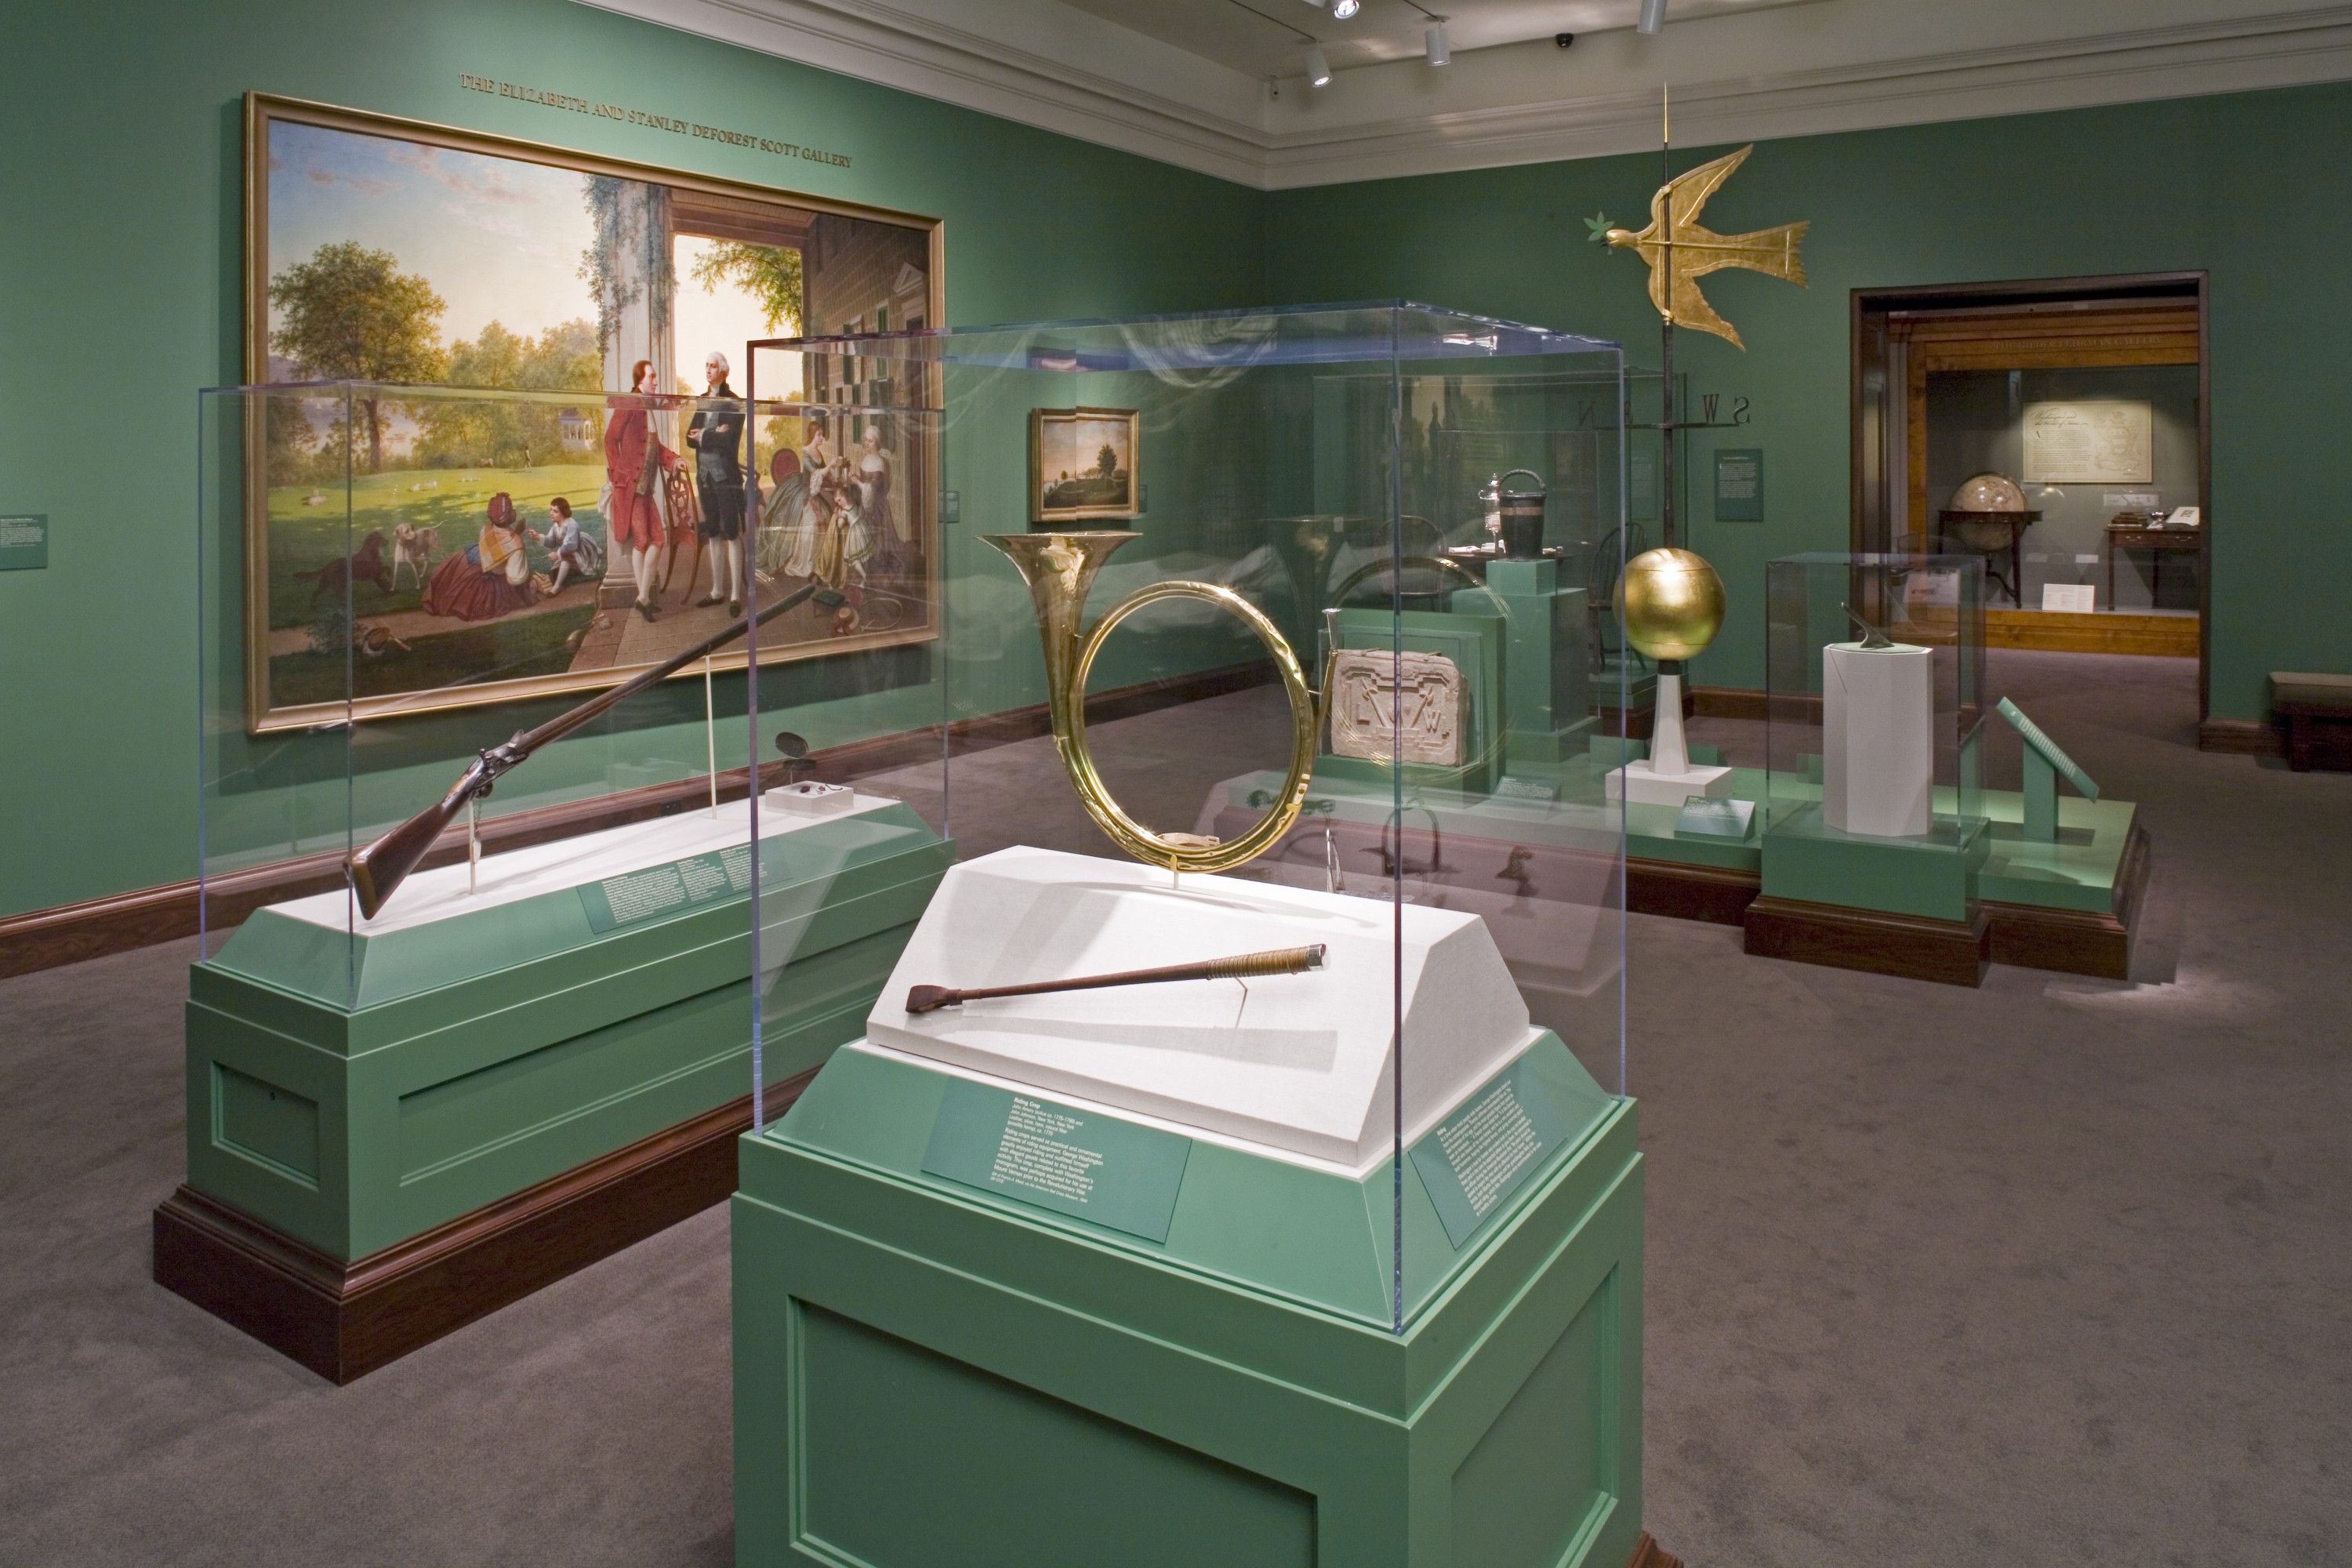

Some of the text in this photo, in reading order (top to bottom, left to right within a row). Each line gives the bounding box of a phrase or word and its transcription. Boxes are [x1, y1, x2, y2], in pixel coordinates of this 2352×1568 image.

[460, 73, 852, 169] THE ELIZABETH AND STANLEY DEFOREST SCOTT GALLERY
[1702, 394, 1720, 423] W
[1356, 702, 1441, 733] L W
